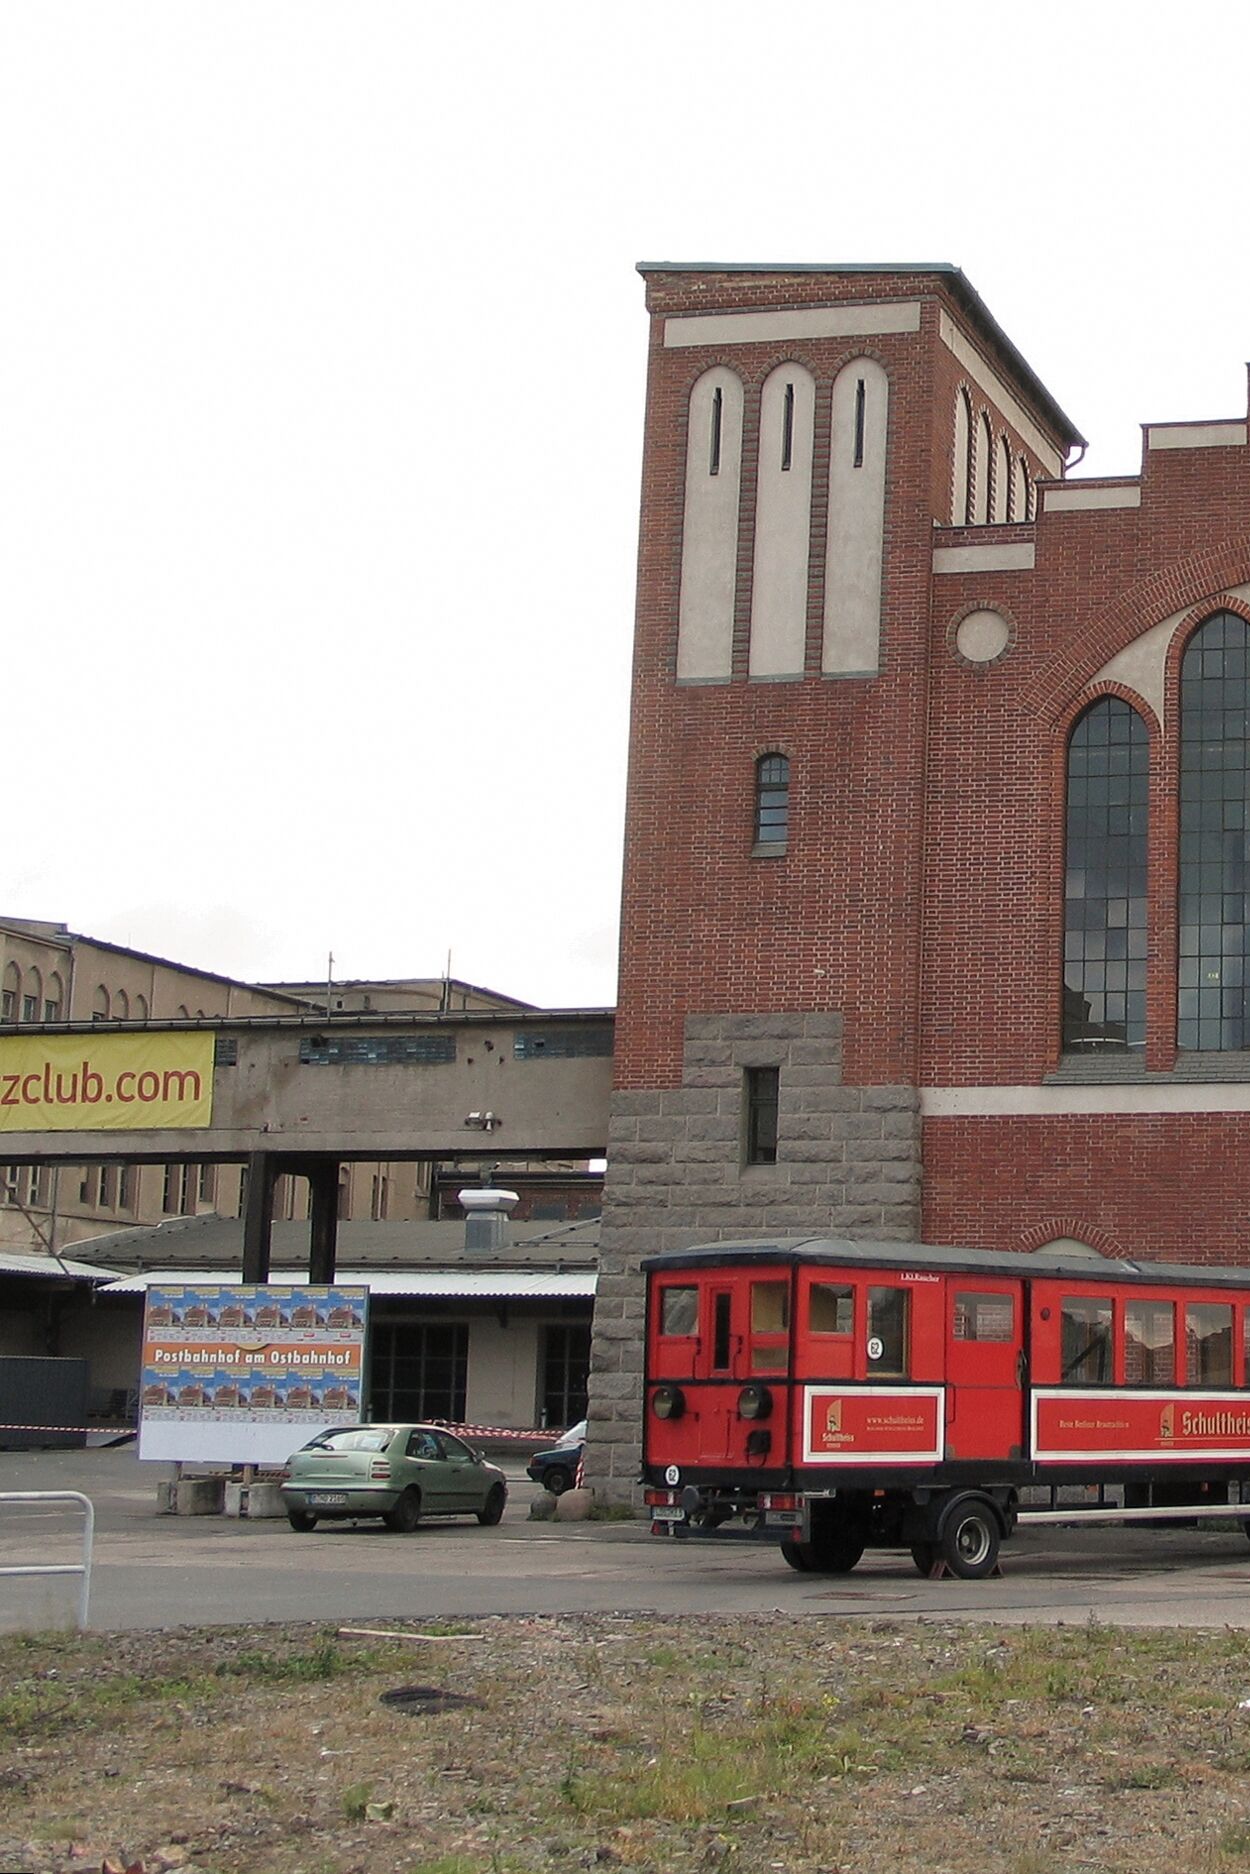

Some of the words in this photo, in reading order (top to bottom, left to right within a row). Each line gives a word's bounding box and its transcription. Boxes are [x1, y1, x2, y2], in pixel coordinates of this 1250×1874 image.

[1, 1061, 201, 1105] zclub.com
[870, 1342, 880, 1355] 62
[155, 1349, 240, 1363] Postbahnhof
[245, 1353, 265, 1364] am
[271, 1350, 350, 1365] Ostbahnhof
[668, 1469, 677, 1483] 62
